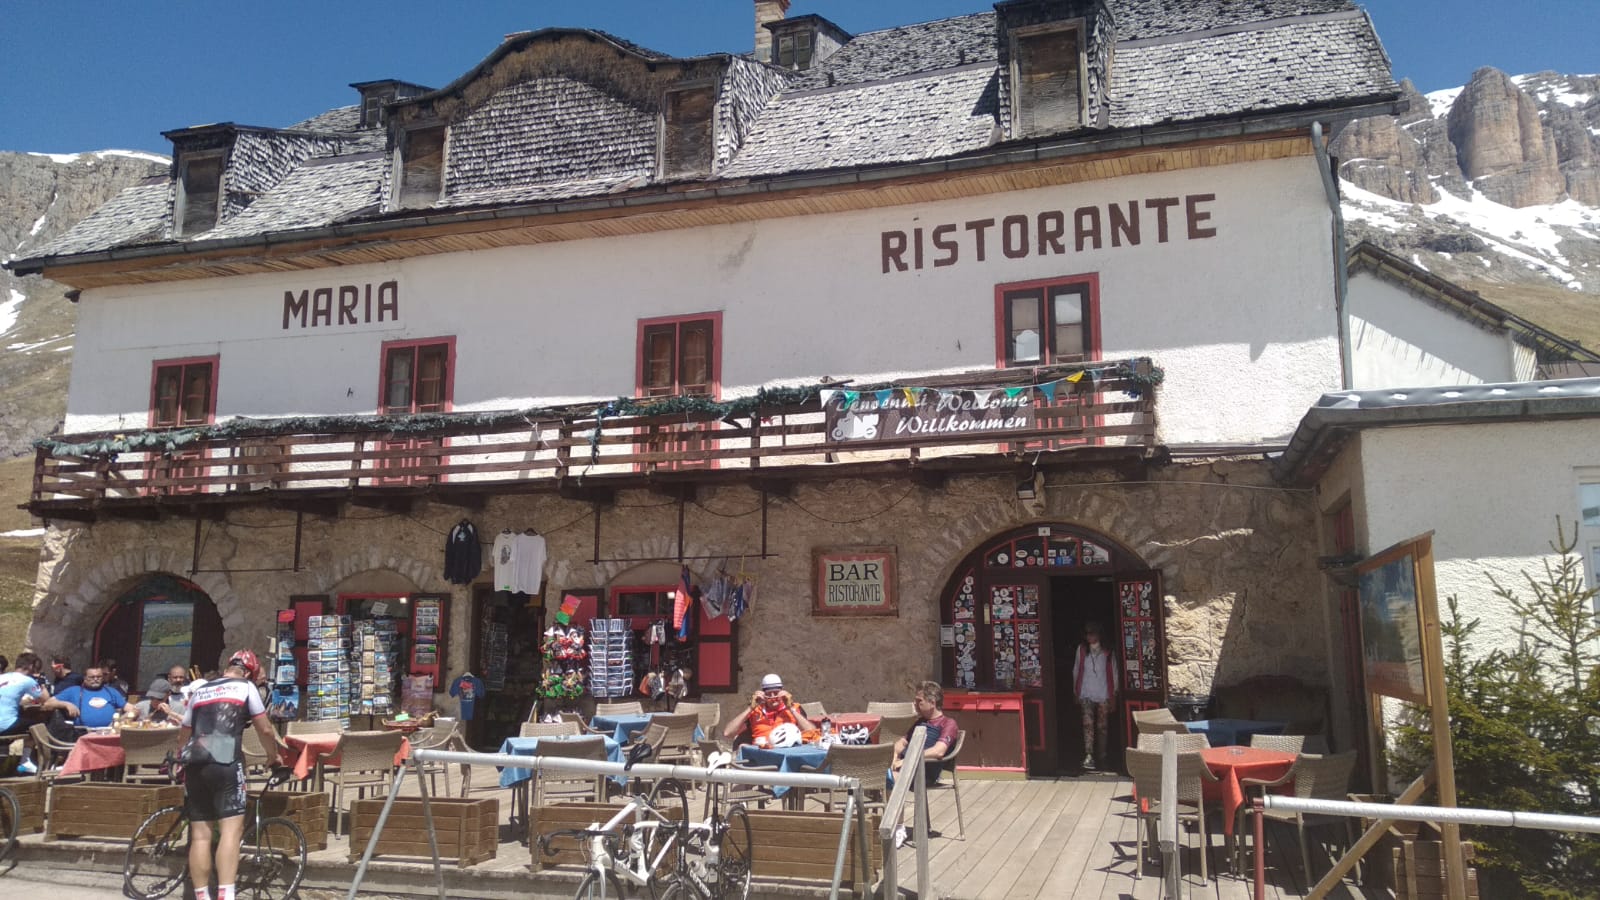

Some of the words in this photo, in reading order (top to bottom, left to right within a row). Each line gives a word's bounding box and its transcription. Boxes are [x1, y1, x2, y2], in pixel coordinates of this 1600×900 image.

[881, 193, 1216, 273] RISTORANTE
[282, 280, 398, 329] MARIA
[895, 414, 1027, 434] Willkommen
[829, 563, 879, 581] BAR
[828, 583, 881, 602] RISTORANTE
